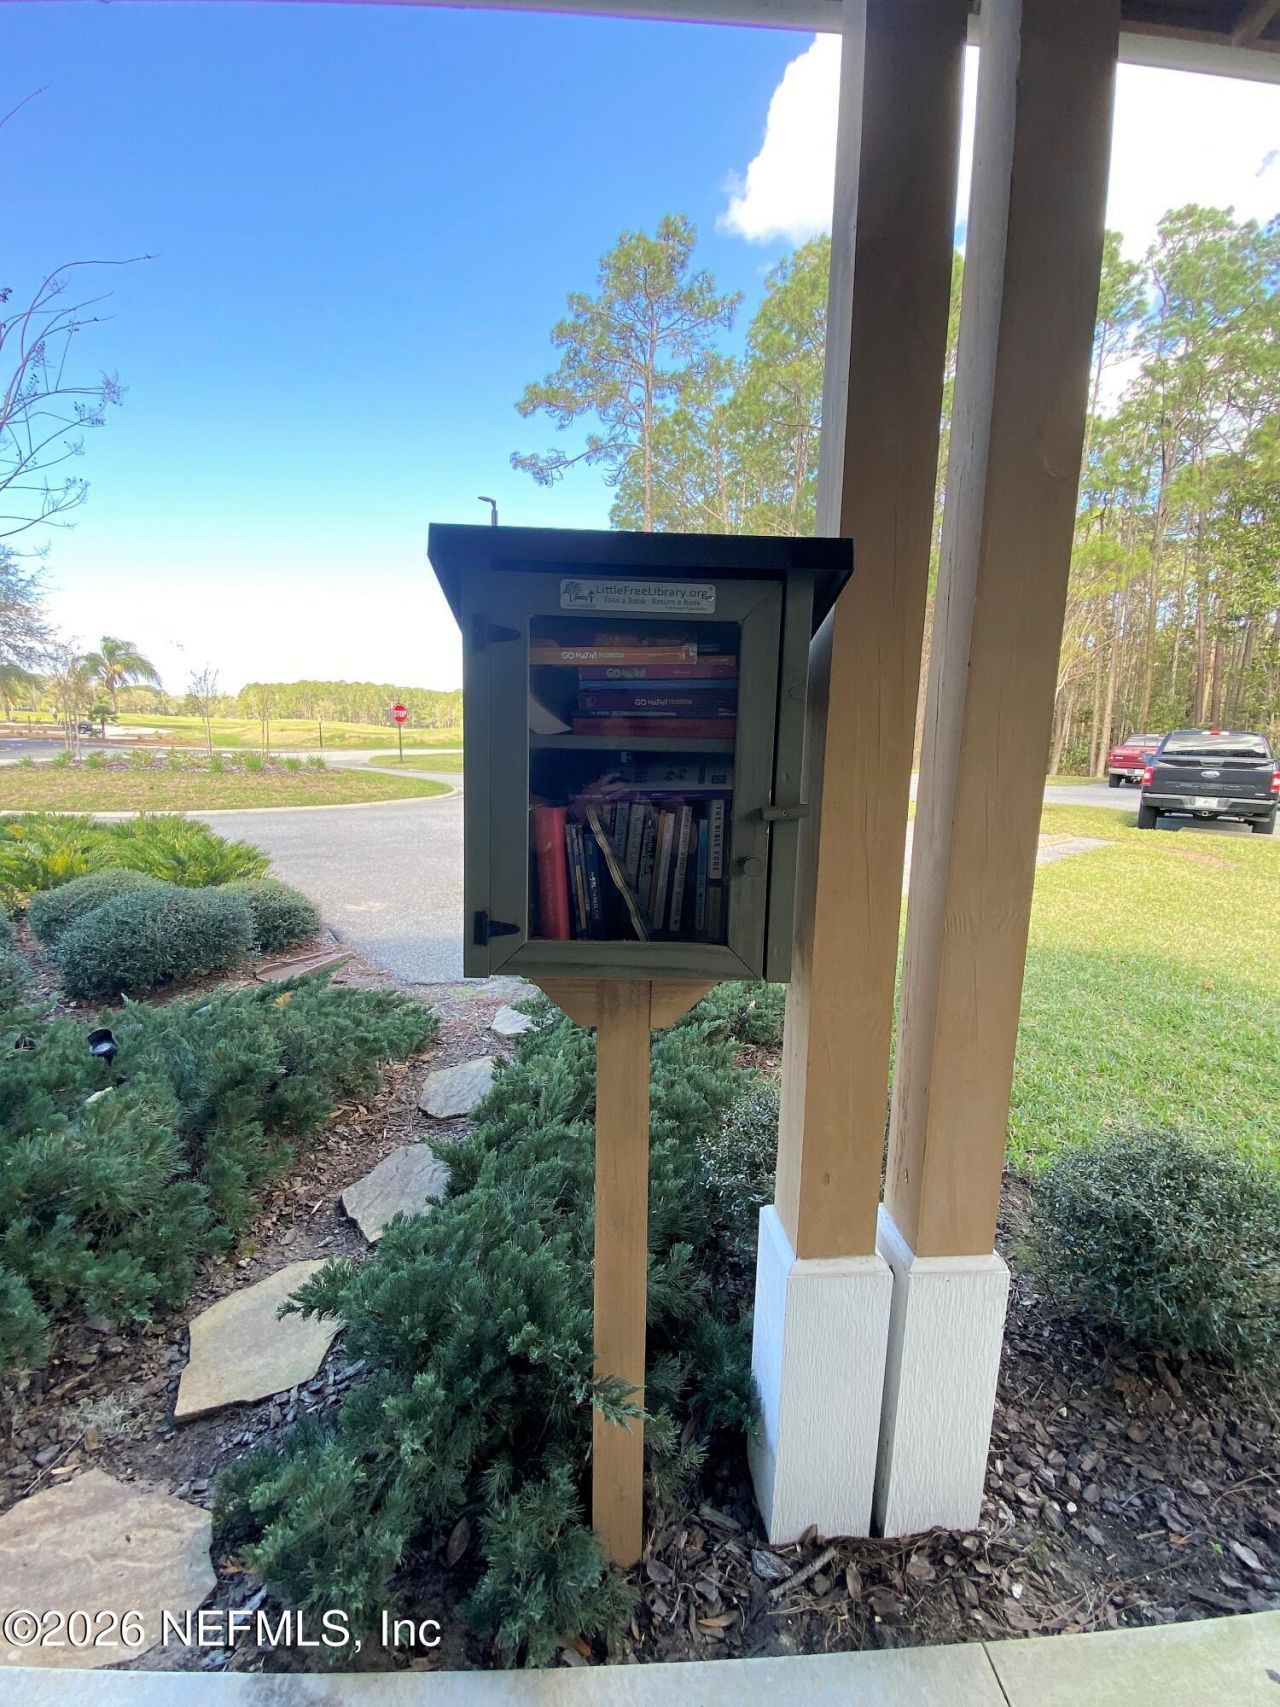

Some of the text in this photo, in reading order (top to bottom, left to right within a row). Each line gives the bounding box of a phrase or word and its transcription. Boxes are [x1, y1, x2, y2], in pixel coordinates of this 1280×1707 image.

[596, 584, 708, 600] LittleFreeLibrary.org
[604, 596, 621, 605] Take
[628, 597, 646, 605] Book
[651, 597, 677, 606] Return
[683, 598, 701, 607] Book
[561, 651, 575, 660] GO
[606, 668, 620, 678] GO
[634, 698, 647, 706] GO
[394, 710, 407, 718] STOP
[713, 825, 721, 848] BIBLE
[712, 850, 720, 873] CODE
